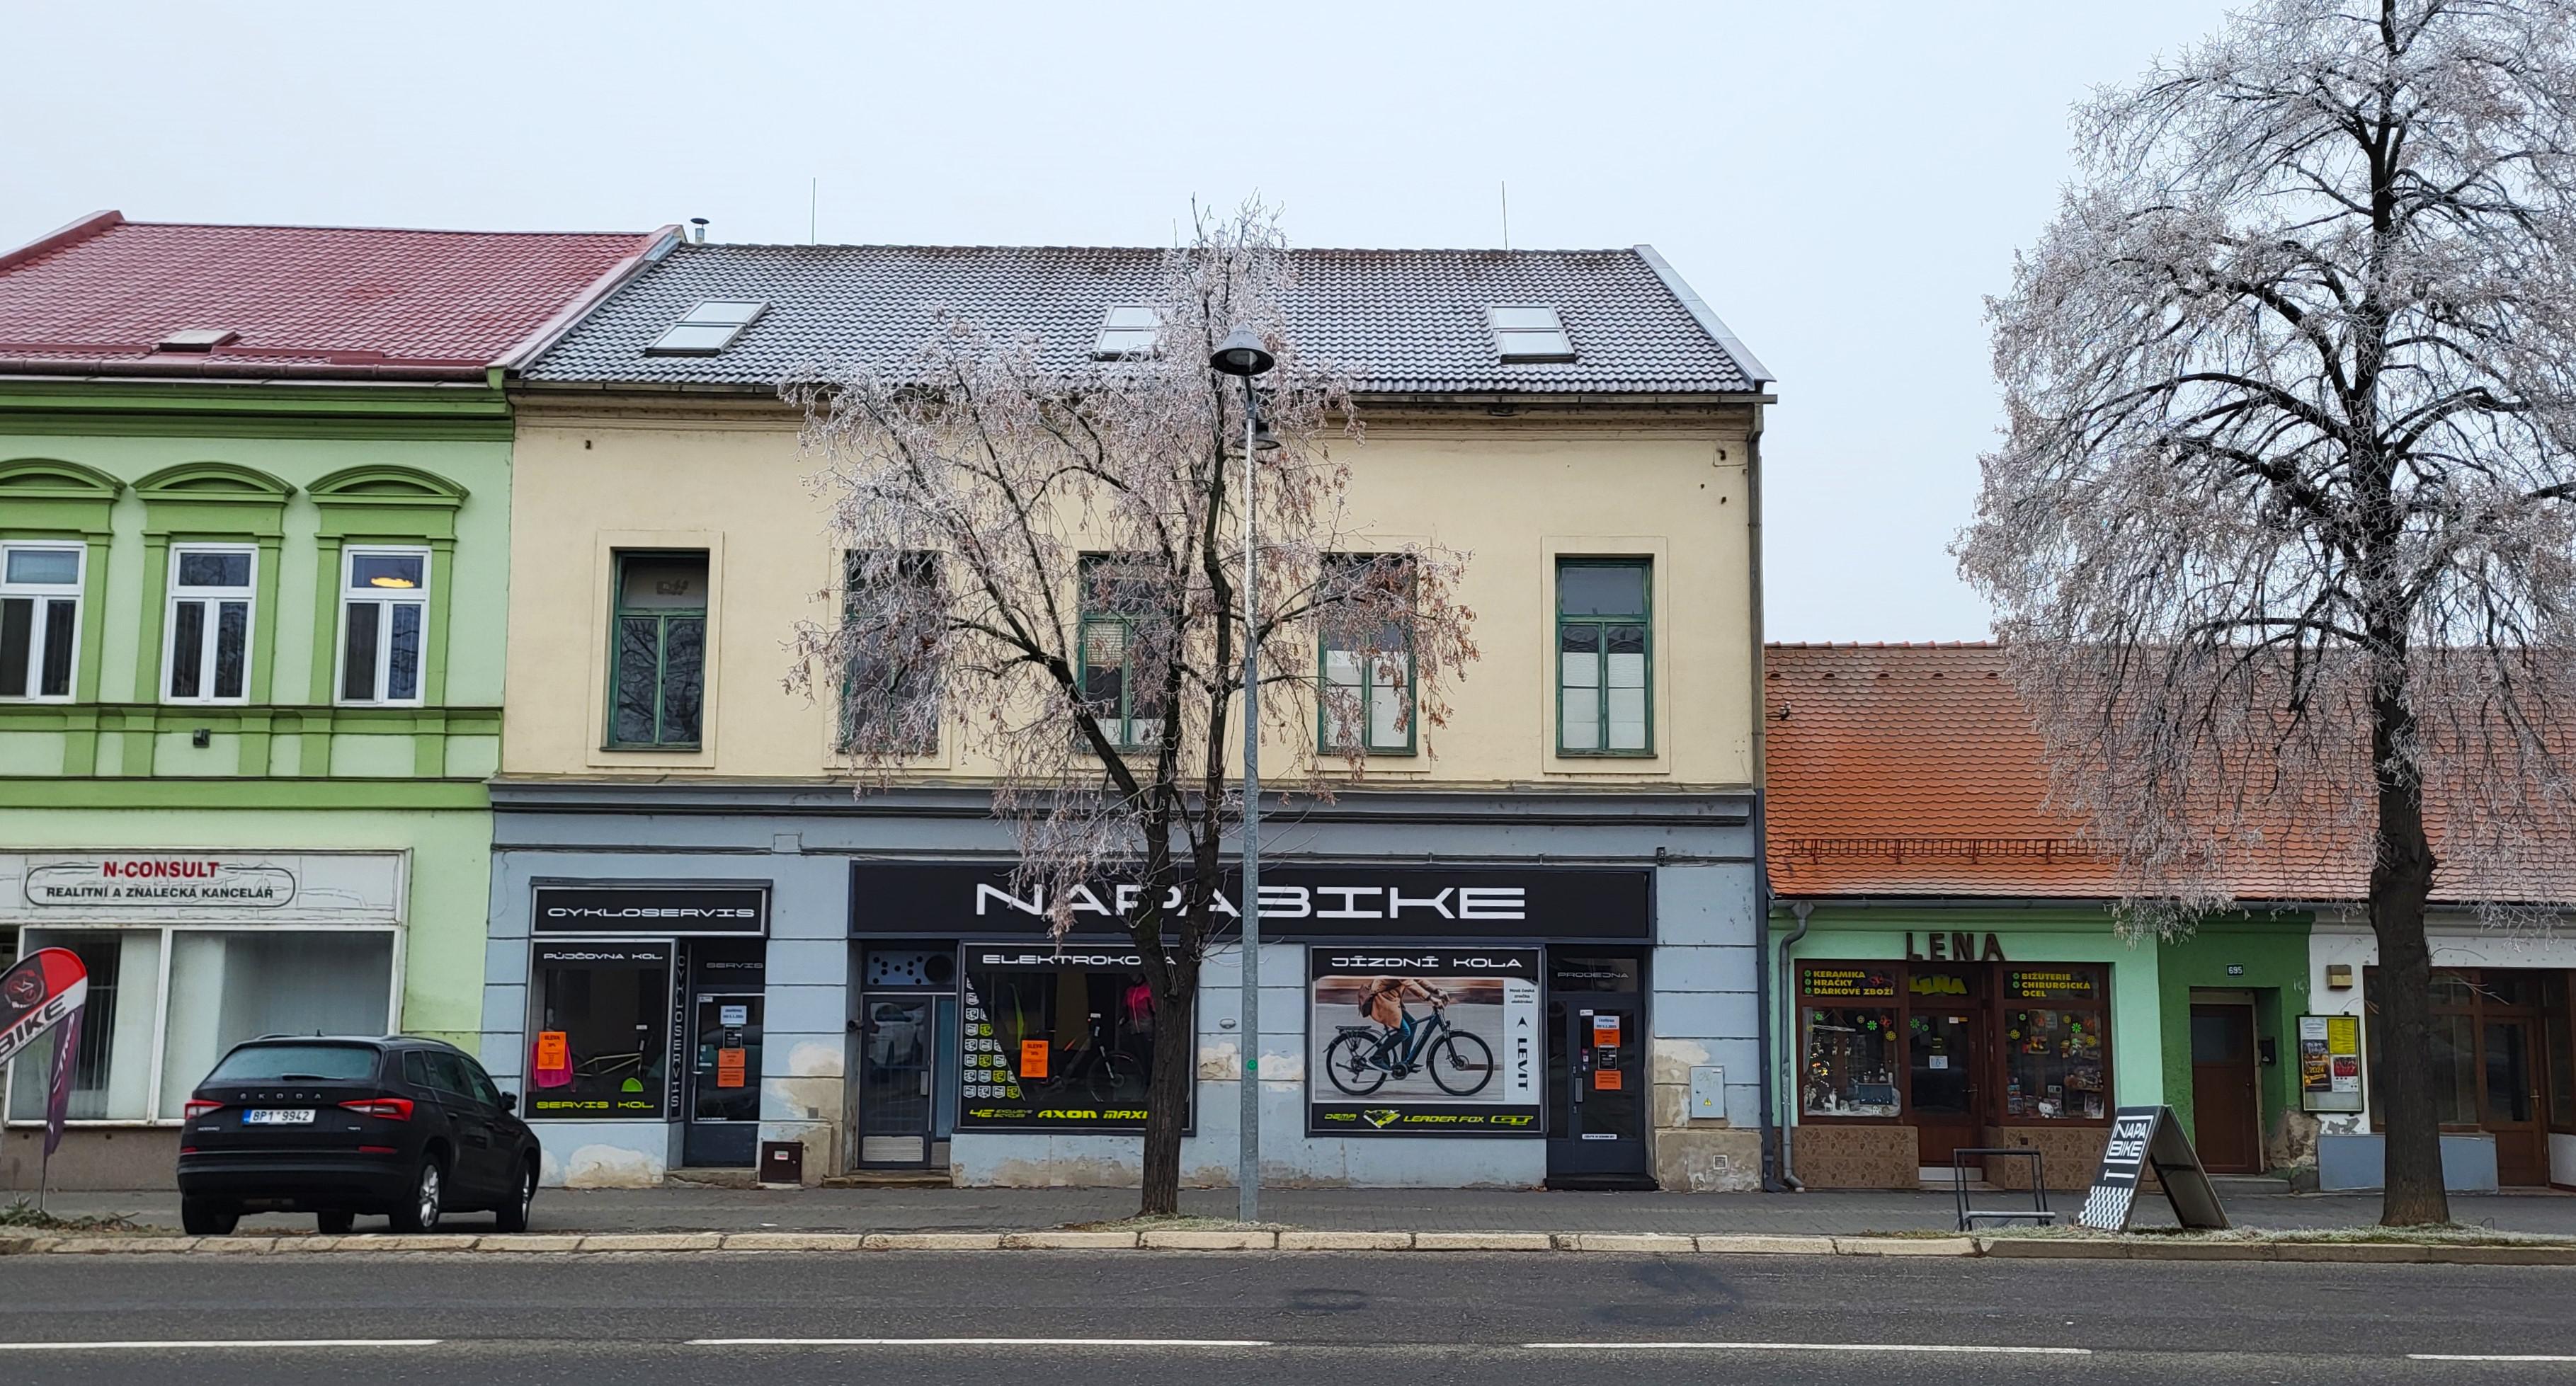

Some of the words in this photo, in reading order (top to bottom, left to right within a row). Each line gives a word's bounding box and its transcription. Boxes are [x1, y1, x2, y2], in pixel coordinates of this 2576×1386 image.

[103, 861, 220, 878] N-CONSULT
[113, 888, 122, 898] A
[547, 907, 755, 918] CYKLOSERVIS
[1905, 932, 2005, 962] LENA
[982, 954, 1177, 965] ELEKTROKOA
[1331, 956, 1440, 968] JÍZDNÍ
[1453, 958, 1522, 968] KOLA
[1813, 978, 1853, 986] HRAČKY
[2022, 980, 2091, 989] CHIRURGICKÁ
[671, 956, 685, 1107] CYKLOSERVIS
[1517, 1038, 1528, 1092] LEVIT
[252, 1111, 273, 1121] 8P1
[282, 1111, 309, 1121] 9942
[2114, 1123, 2147, 1138] NAPA
[2109, 1140, 2143, 1157] BIKE
